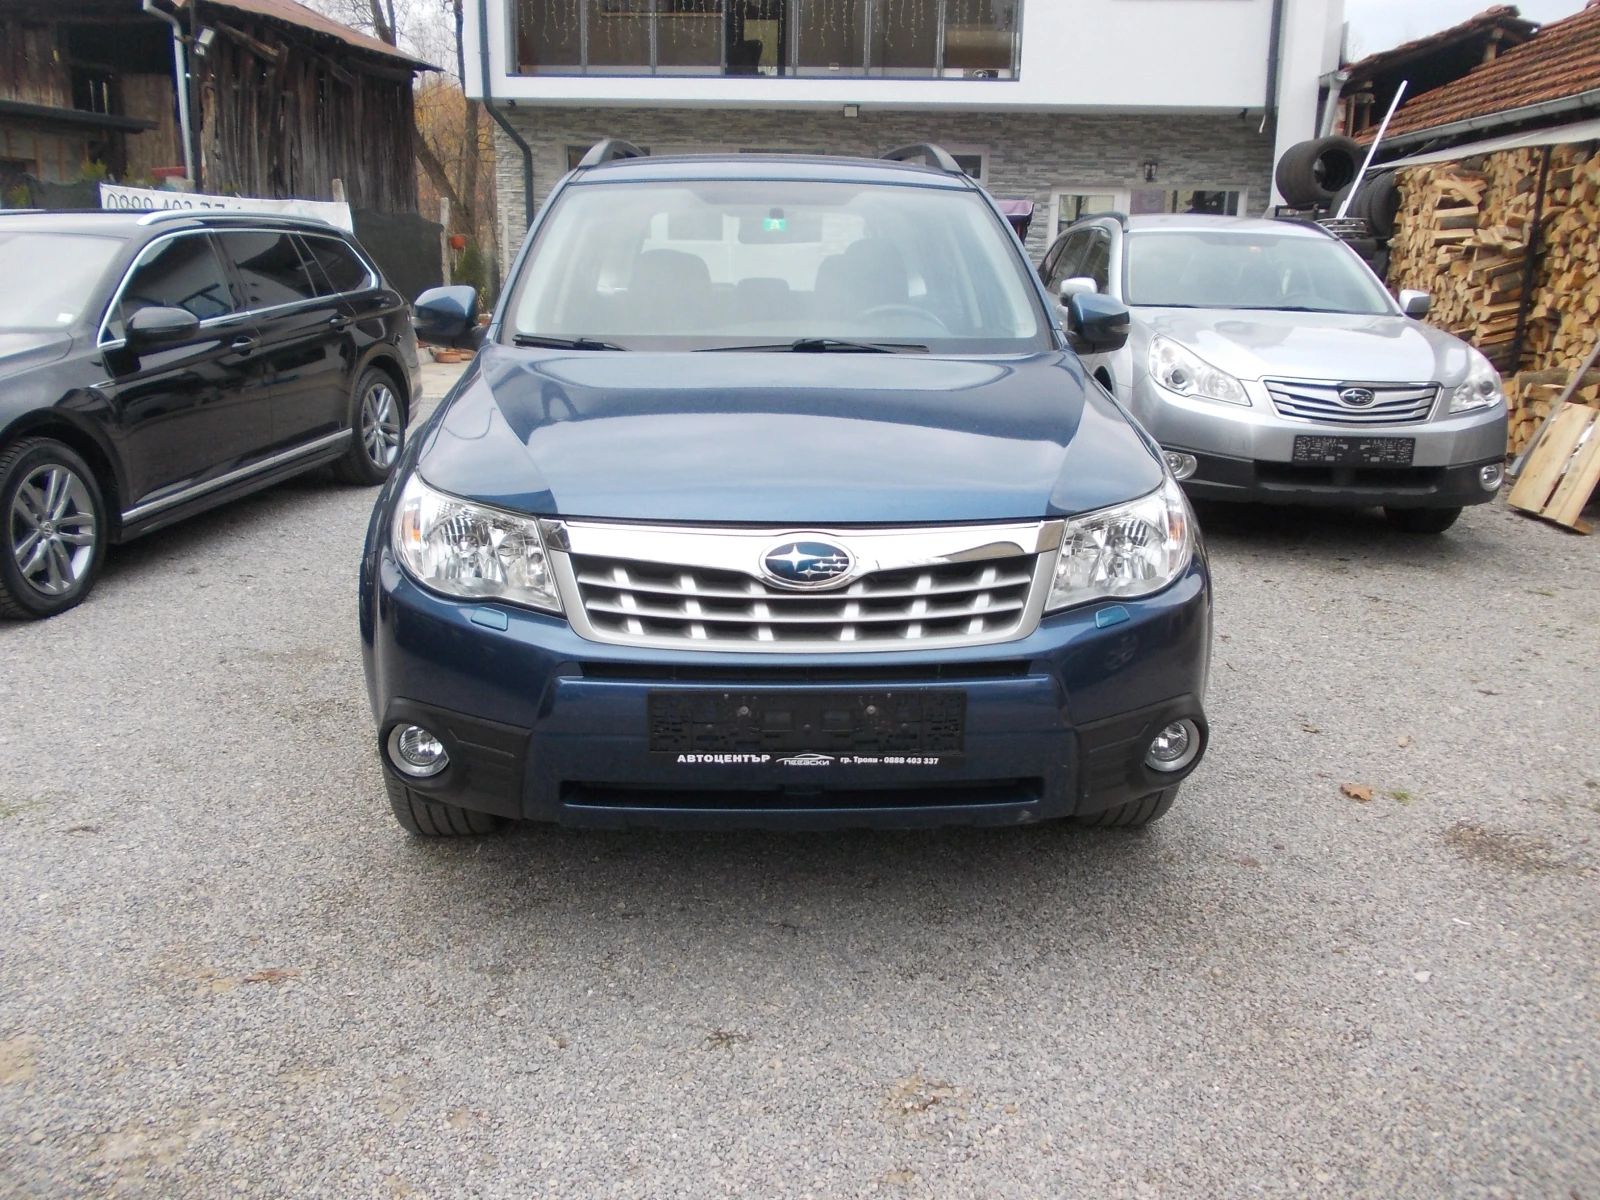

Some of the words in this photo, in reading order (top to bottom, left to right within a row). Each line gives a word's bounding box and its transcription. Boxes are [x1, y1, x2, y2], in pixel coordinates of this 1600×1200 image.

[677, 754, 771, 764] АВТОЦЕНТЪР
[853, 756, 878, 764] Троян
[884, 756, 905, 764] 0888
[923, 757, 939, 765] 337
